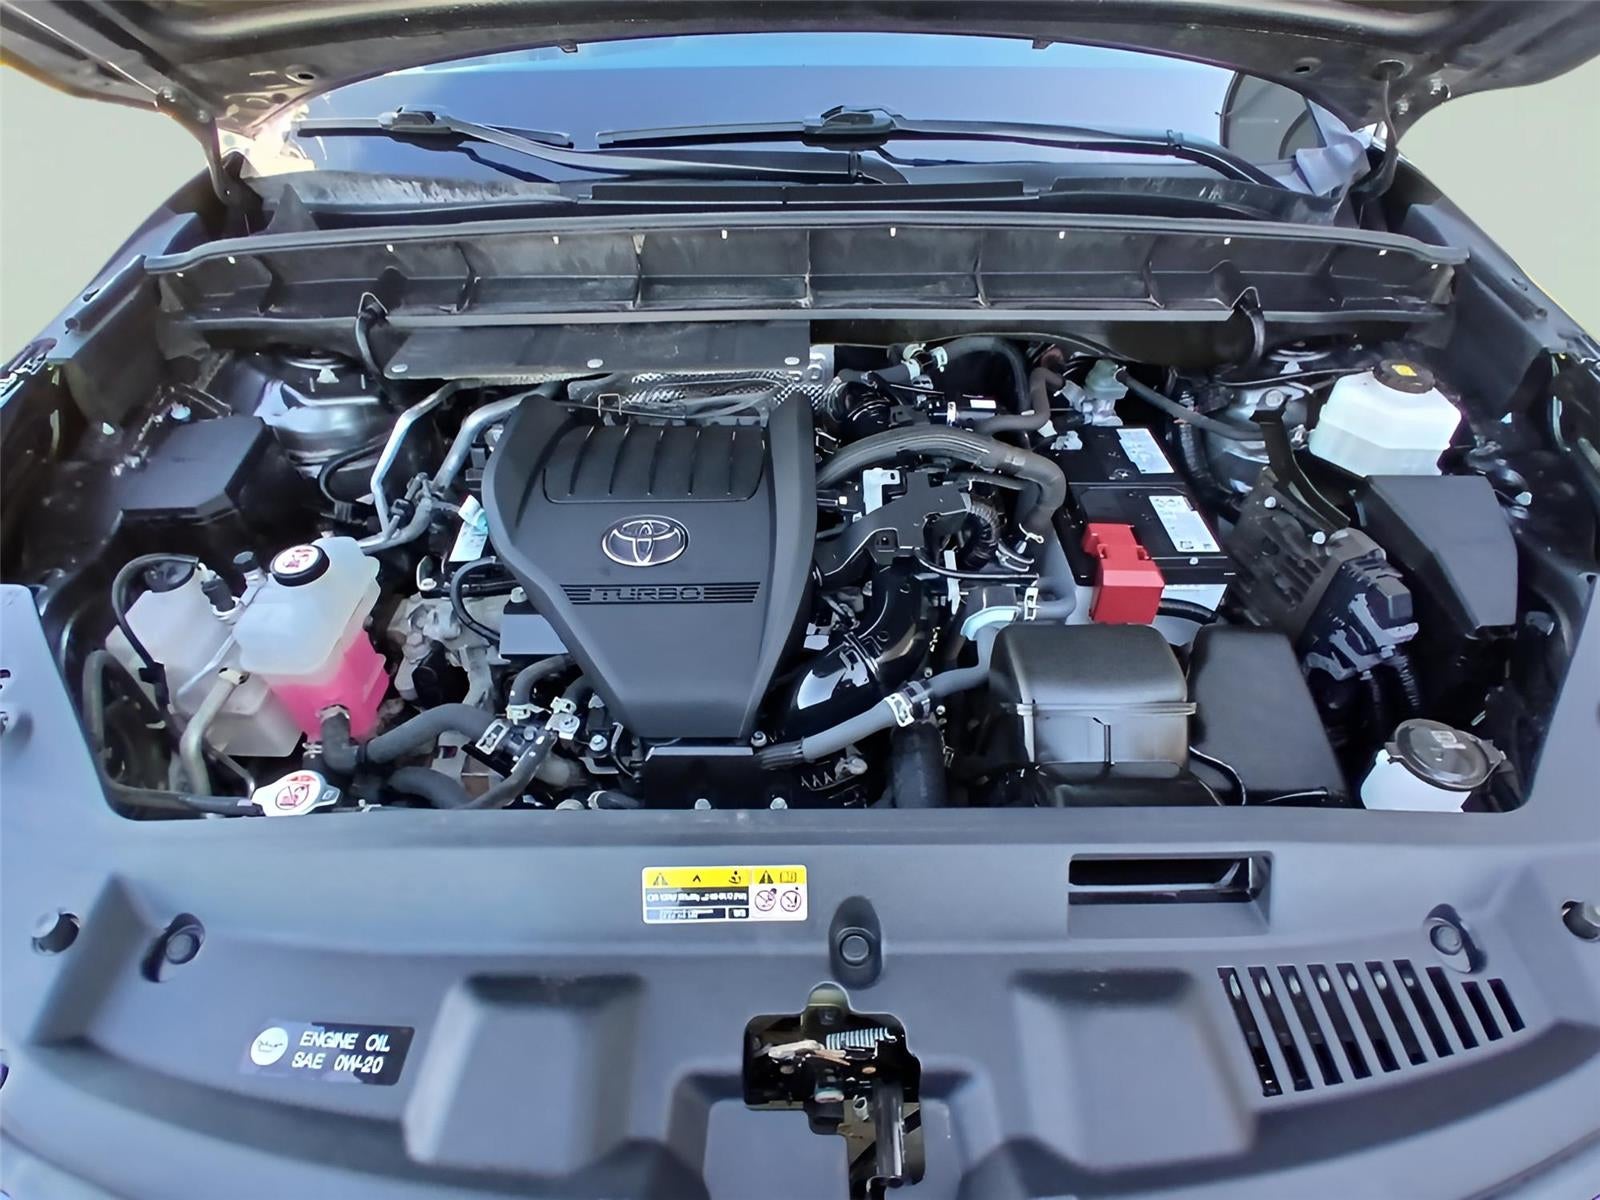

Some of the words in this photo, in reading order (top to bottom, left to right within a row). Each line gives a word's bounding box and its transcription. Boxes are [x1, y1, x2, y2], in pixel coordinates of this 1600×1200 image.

[594, 587, 702, 600] TURBO
[299, 1030, 359, 1050] ENGINE
[365, 1034, 391, 1053] OIL
[291, 1052, 326, 1069] SAE
[333, 1055, 384, 1074] 0W-20
